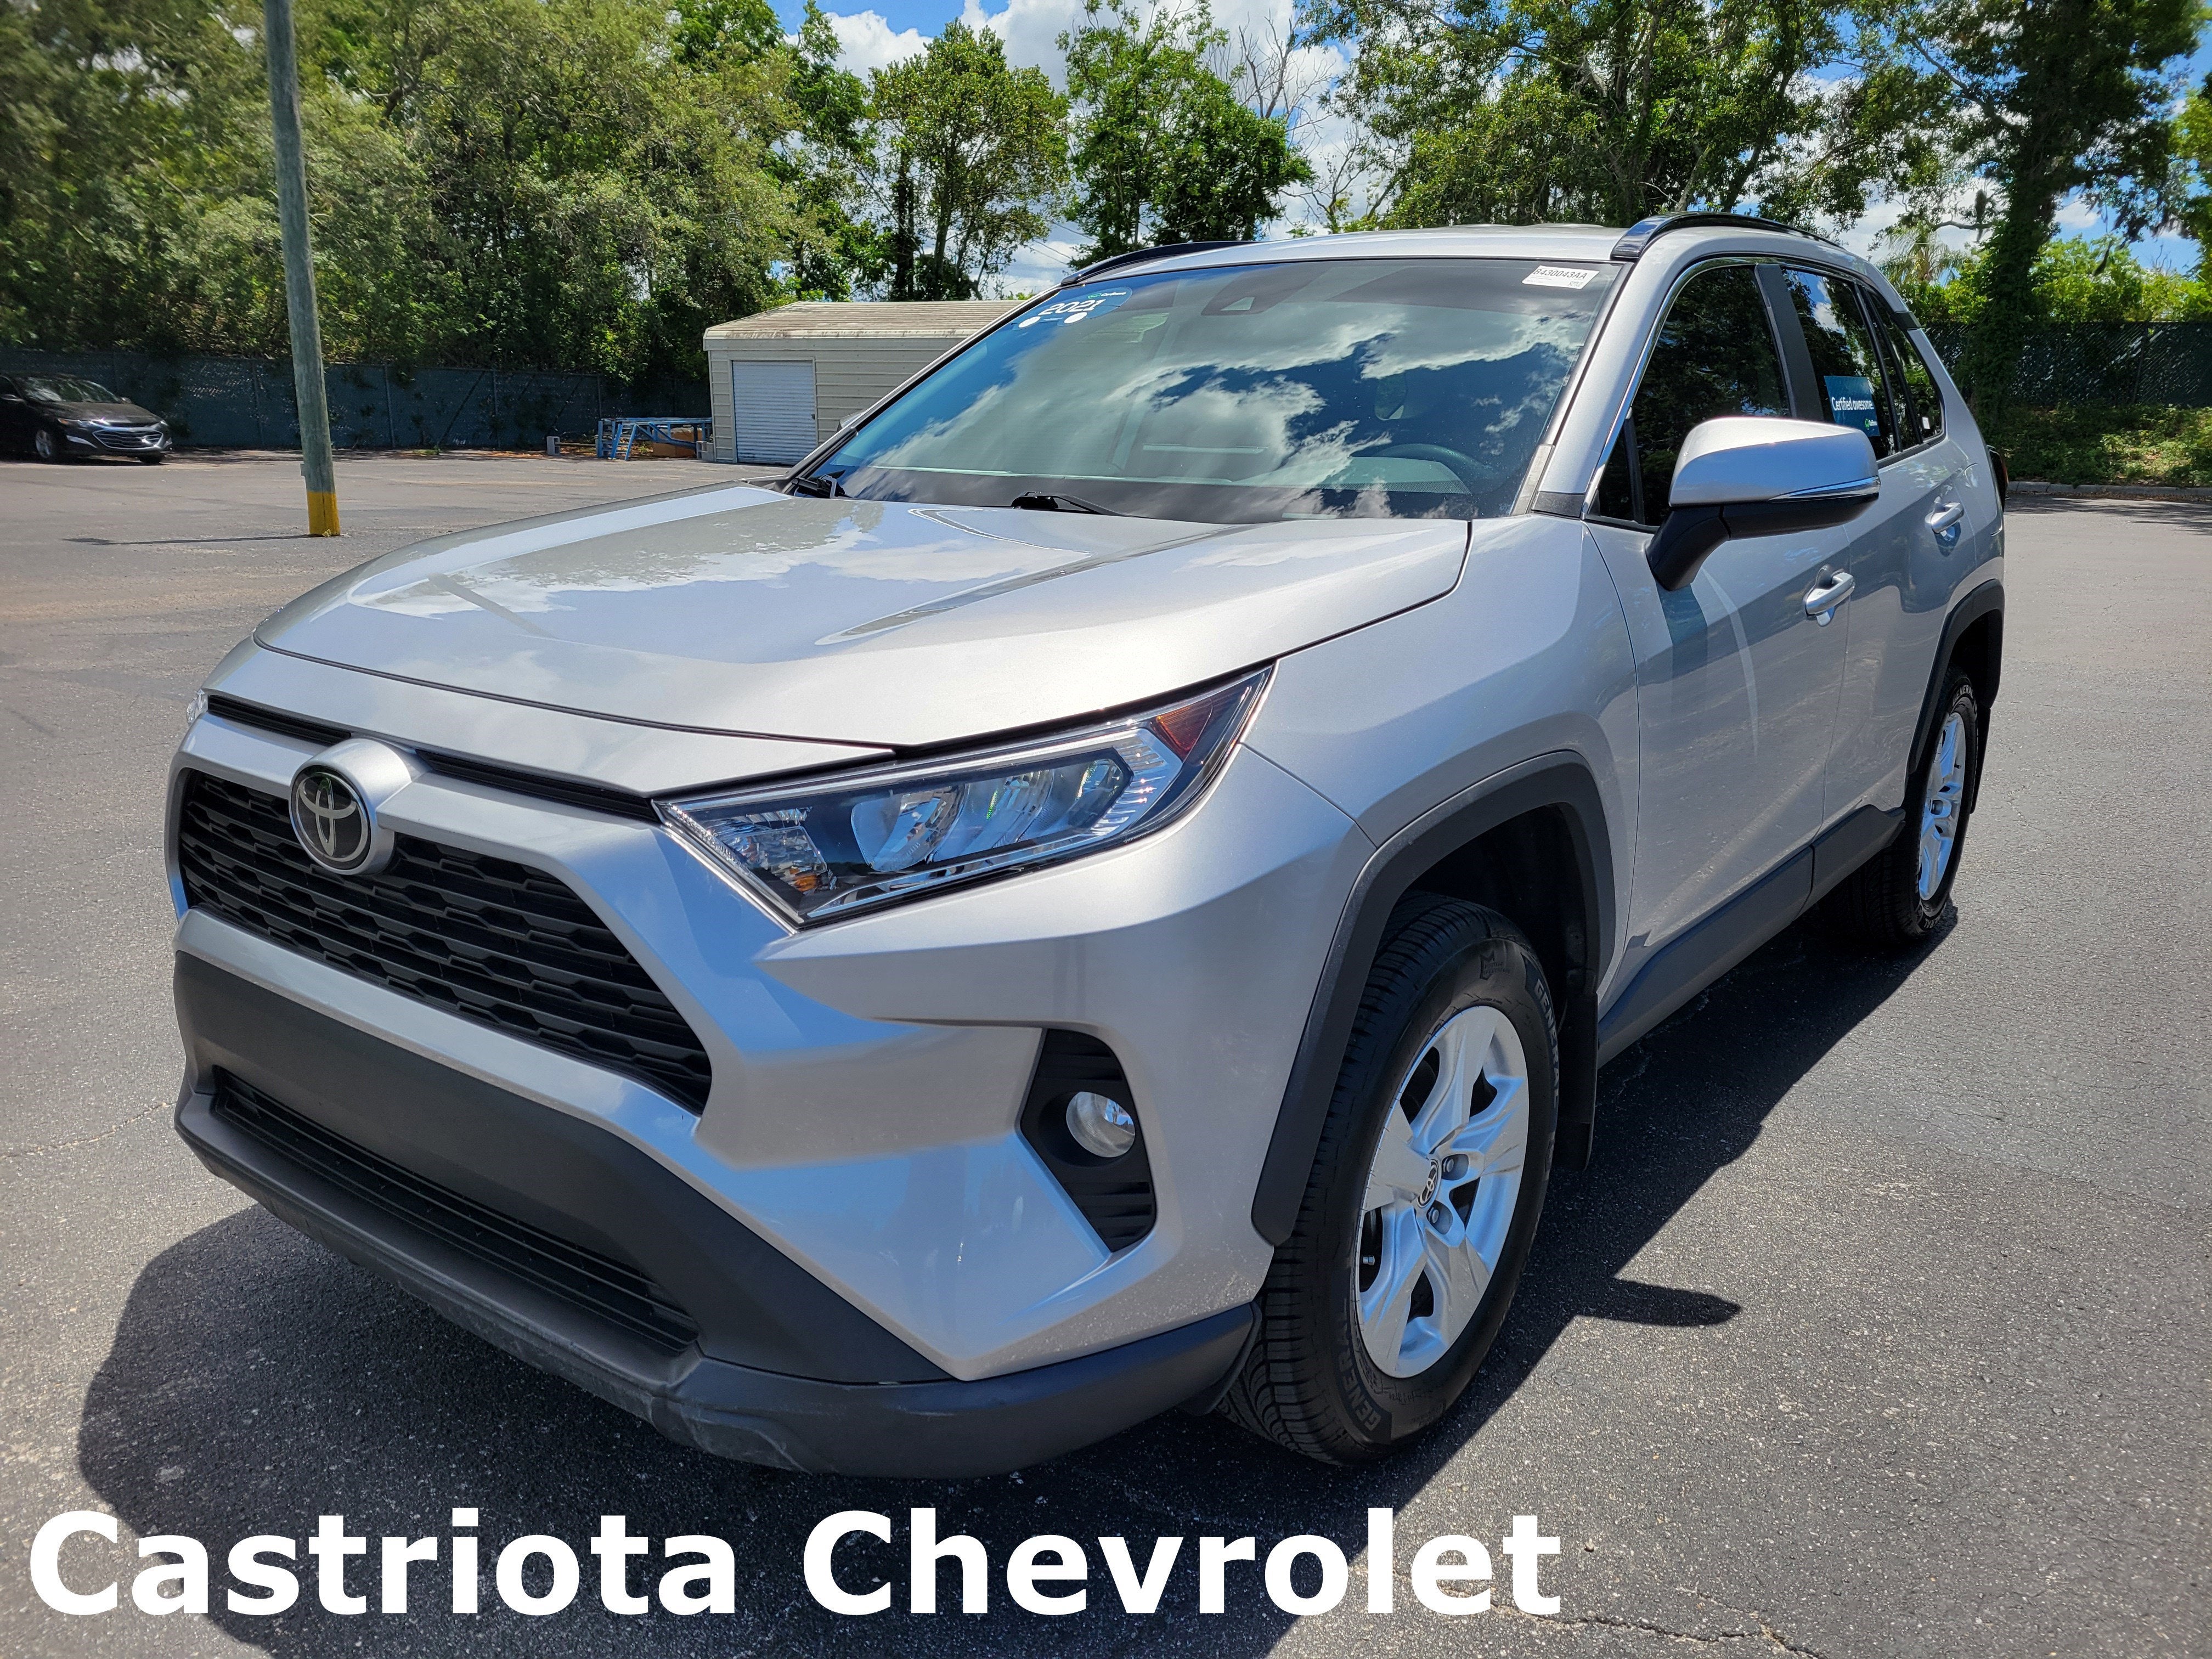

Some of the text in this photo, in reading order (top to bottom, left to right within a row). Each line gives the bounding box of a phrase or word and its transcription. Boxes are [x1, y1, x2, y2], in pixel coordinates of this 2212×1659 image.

[1038, 298, 1107, 315] 2021
[1831, 397, 1875, 411] Certified awesome.
[1534, 978, 1559, 1109] GENERAL
[1337, 1297, 1381, 1431] GENERAL
